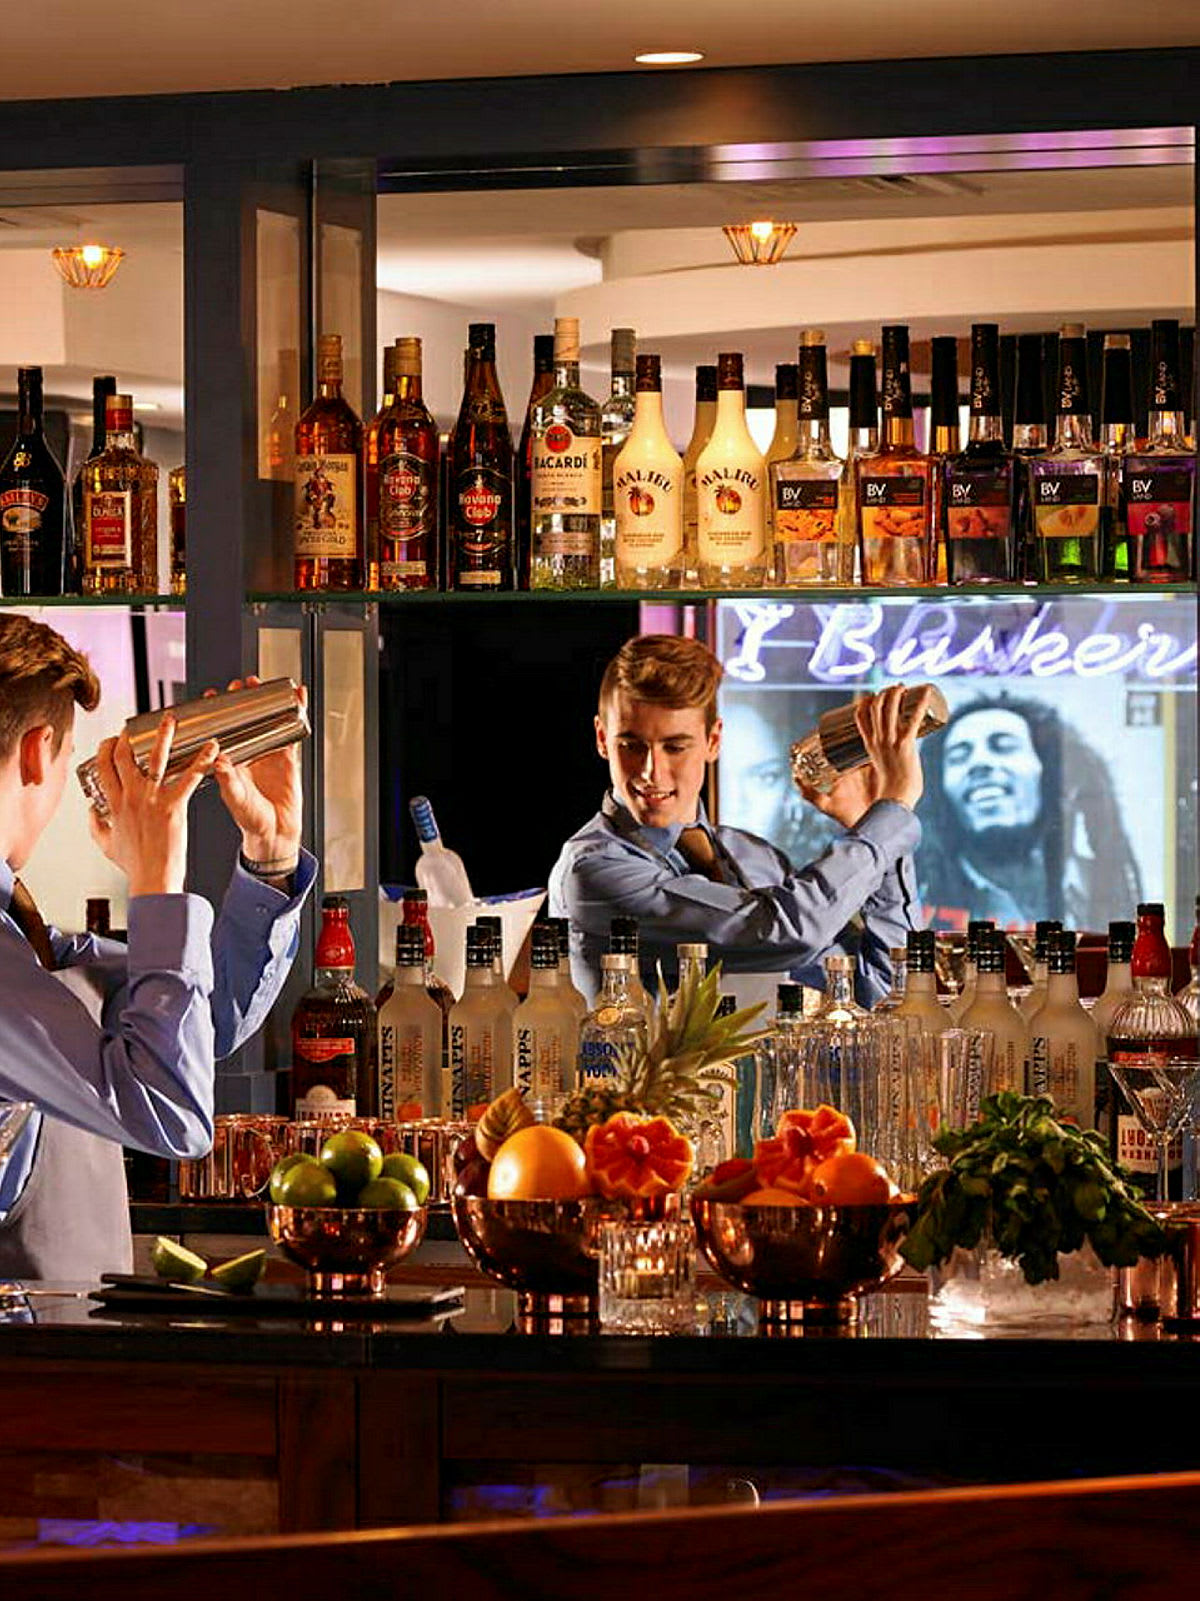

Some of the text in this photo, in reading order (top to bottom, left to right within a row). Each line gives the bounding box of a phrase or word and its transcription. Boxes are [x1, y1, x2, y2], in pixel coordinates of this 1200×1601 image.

[617, 468, 674, 494] MALIBU
[701, 467, 761, 491] MALIBU
[1132, 479, 1153, 494] BV
[782, 487, 802, 500] BV
[866, 483, 887, 497] BV
[952, 483, 972, 498] BV
[1040, 482, 1061, 496] BV
